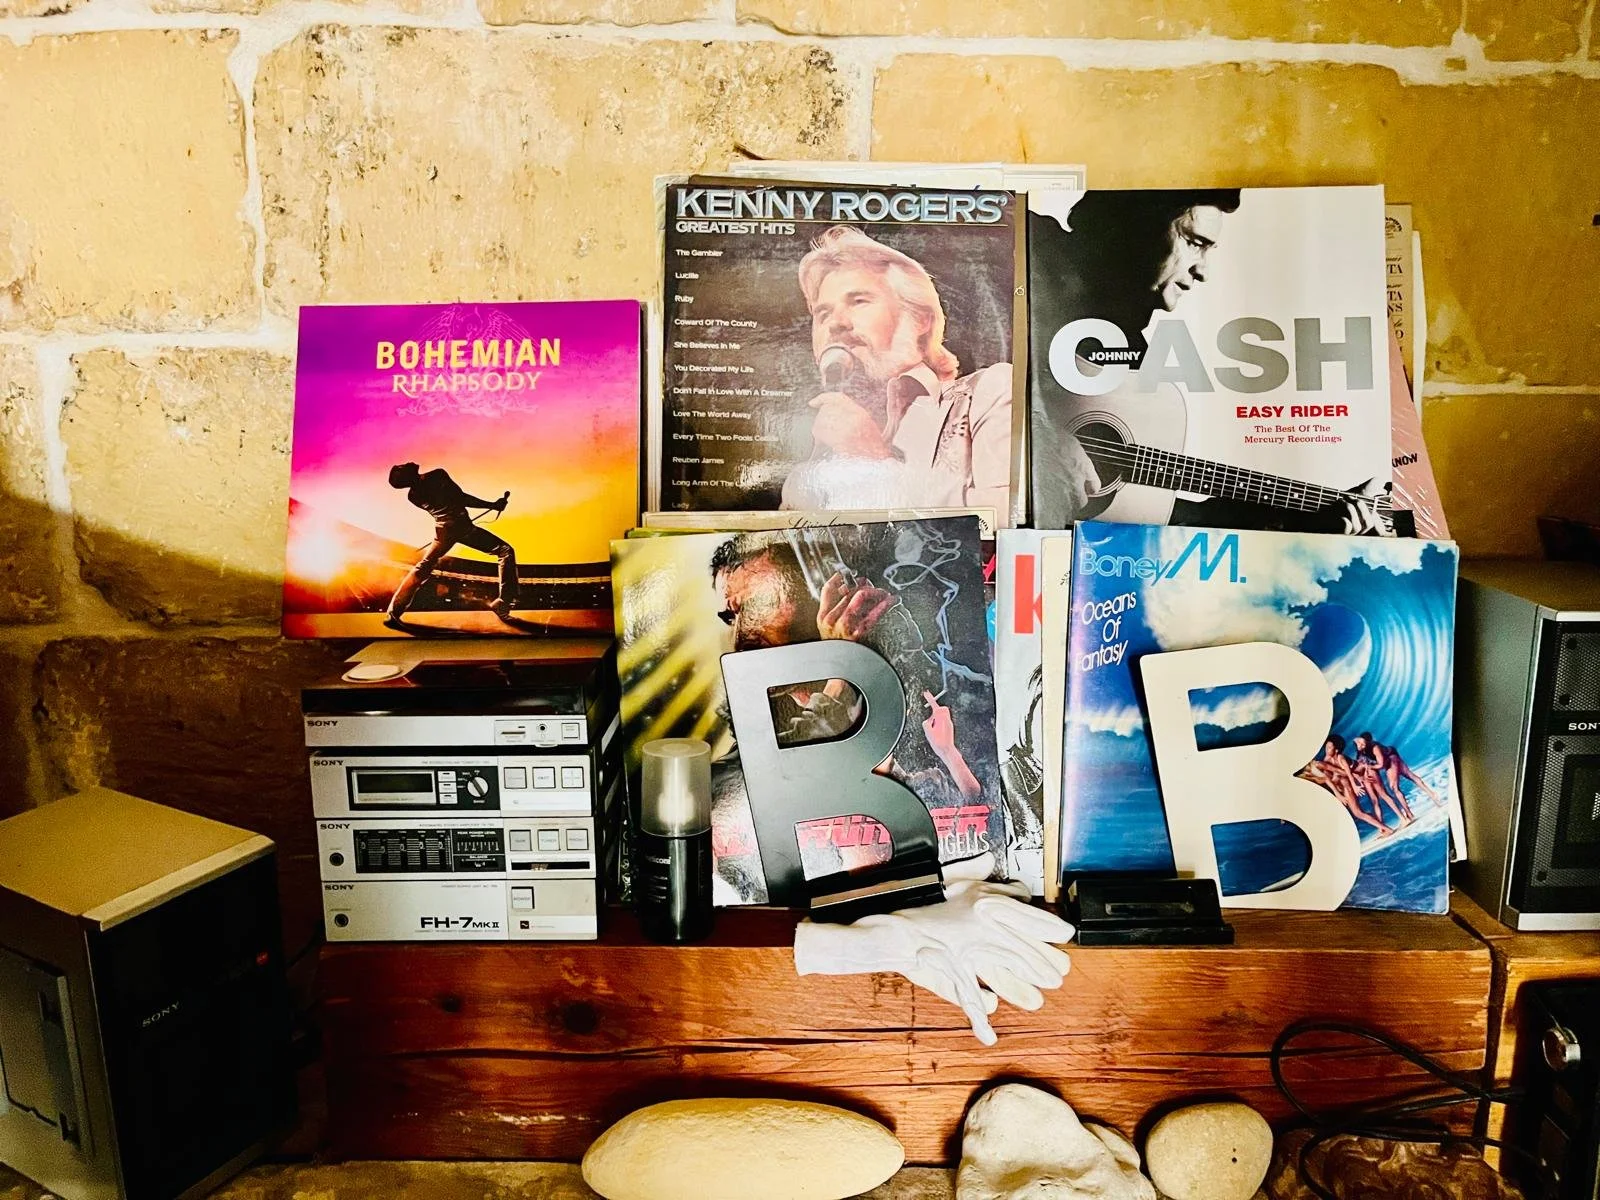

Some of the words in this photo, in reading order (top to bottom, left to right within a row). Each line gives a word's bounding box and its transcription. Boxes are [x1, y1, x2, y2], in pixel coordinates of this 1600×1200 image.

[675, 188, 825, 220] KENNY
[675, 221, 758, 235] GREATEST
[760, 223, 796, 236] HITS
[675, 249, 690, 257] The
[691, 249, 724, 257] Gambler
[674, 271, 700, 280] Lucille
[674, 294, 695, 304] Ruby
[674, 318, 704, 327] Coward
[704, 319, 715, 327] Of
[715, 319, 730, 327] The
[730, 319, 758, 329] County
[673, 341, 687, 350] She
[689, 341, 720, 350] Believes
[720, 342, 728, 350] In
[728, 342, 741, 350] Me
[376, 338, 562, 370] BOHEMIAN
[1048, 316, 1375, 396] CASH
[1088, 351, 1141, 361] JOHNNY
[674, 364, 689, 372] You
[689, 364, 727, 373] Decorated
[727, 365, 740, 374] My
[740, 365, 755, 374] Life
[391, 371, 543, 399] RHAPSODY
[673, 387, 693, 395] Don't
[693, 387, 708, 395] Fall
[708, 387, 716, 395] In
[716, 388, 735, 396] Love
[735, 388, 753, 396] With
[760, 389, 794, 397] Dreamer
[672, 410, 692, 418] Love
[692, 410, 707, 418] The
[707, 411, 730, 419] World
[731, 411, 752, 420] Away
[1236, 405, 1284, 418] EASY
[1290, 404, 1349, 418] RIDER
[1254, 425, 1273, 433] The
[1275, 424, 1296, 433] Best
[1298, 424, 1311, 433] Of
[1312, 424, 1331, 433] The
[672, 433, 694, 441] Every
[695, 433, 715, 441] Time
[732, 434, 753, 442] Fools
[1244, 435, 1285, 445] Mercury
[1287, 434, 1342, 444] Recordings
[672, 456, 701, 464] Reuben
[701, 457, 725, 465] James
[1391, 452, 1418, 468] NOW
[672, 479, 691, 487] Long
[720, 480, 735, 488] The
[671, 502, 690, 510] Lady
[1079, 547, 1173, 587] Boney
[1082, 591, 1137, 625] Oceans
[1102, 615, 1122, 643] Of
[1567, 722, 1600, 731] SON
[420, 916, 474, 929] FH-7
[142, 1000, 180, 1027] SONY
